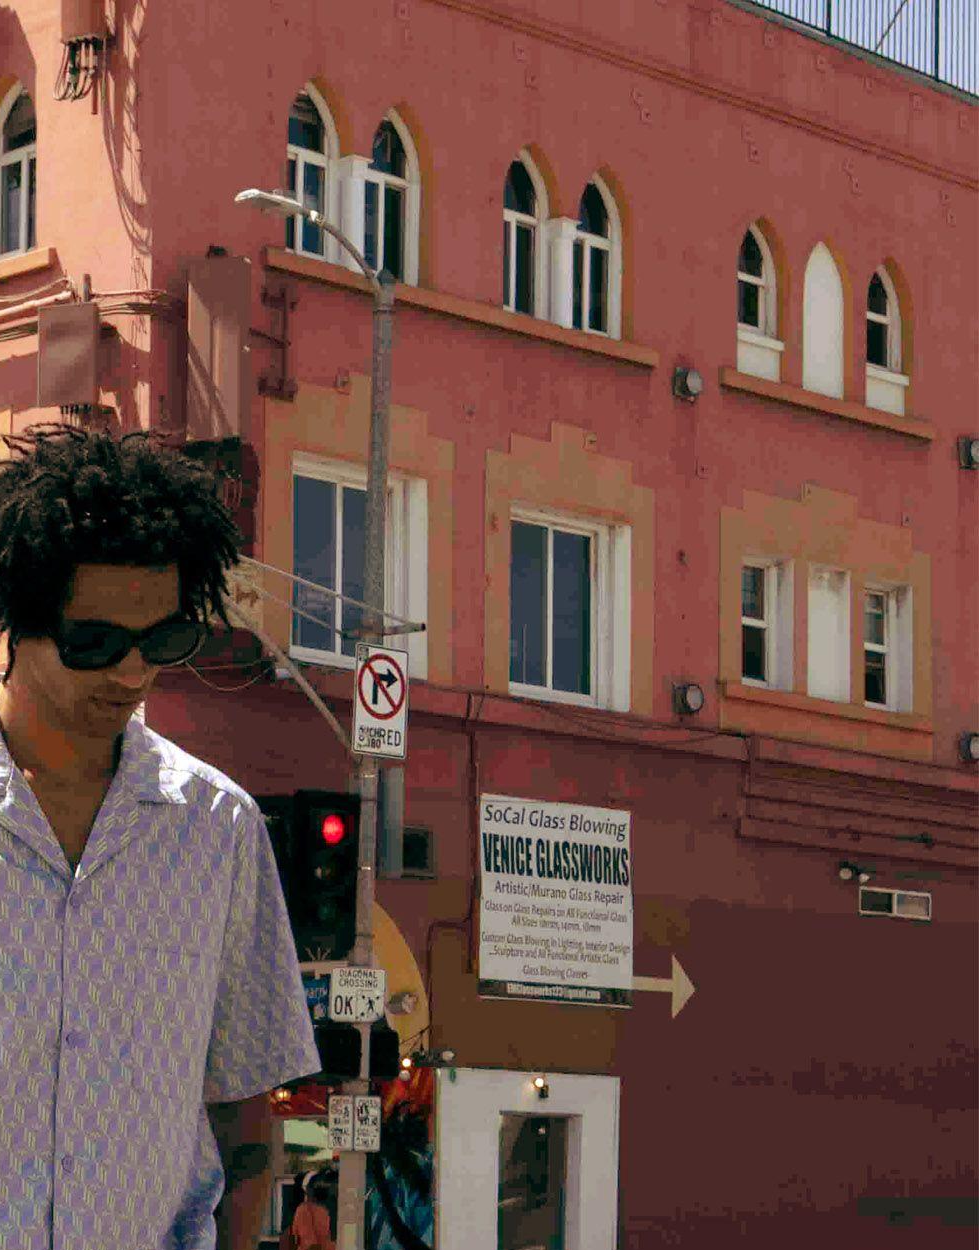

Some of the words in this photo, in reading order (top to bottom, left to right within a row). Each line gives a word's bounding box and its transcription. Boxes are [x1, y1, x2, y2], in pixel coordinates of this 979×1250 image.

[484, 804, 526, 824] SoCal
[529, 810, 565, 829] Glass
[570, 814, 627, 842] Blowing
[482, 832, 533, 876] VENICE
[536, 838, 630, 886] GLASSWORKS
[494, 880, 567, 900] Artistic/Murano
[569, 887, 592, 901] Glass
[595, 890, 624, 907] Repair
[485, 901, 503, 912] Glass
[514, 904, 531, 915] Glass
[532, 905, 556, 918] Repairs
[610, 911, 628, 923] Glass
[507, 933, 523, 944] Glass
[525, 934, 550, 949] Blowing
[338, 979, 378, 989] CROSSING
[339, 969, 378, 979] DIAGONAL
[334, 994, 353, 1015] OK
